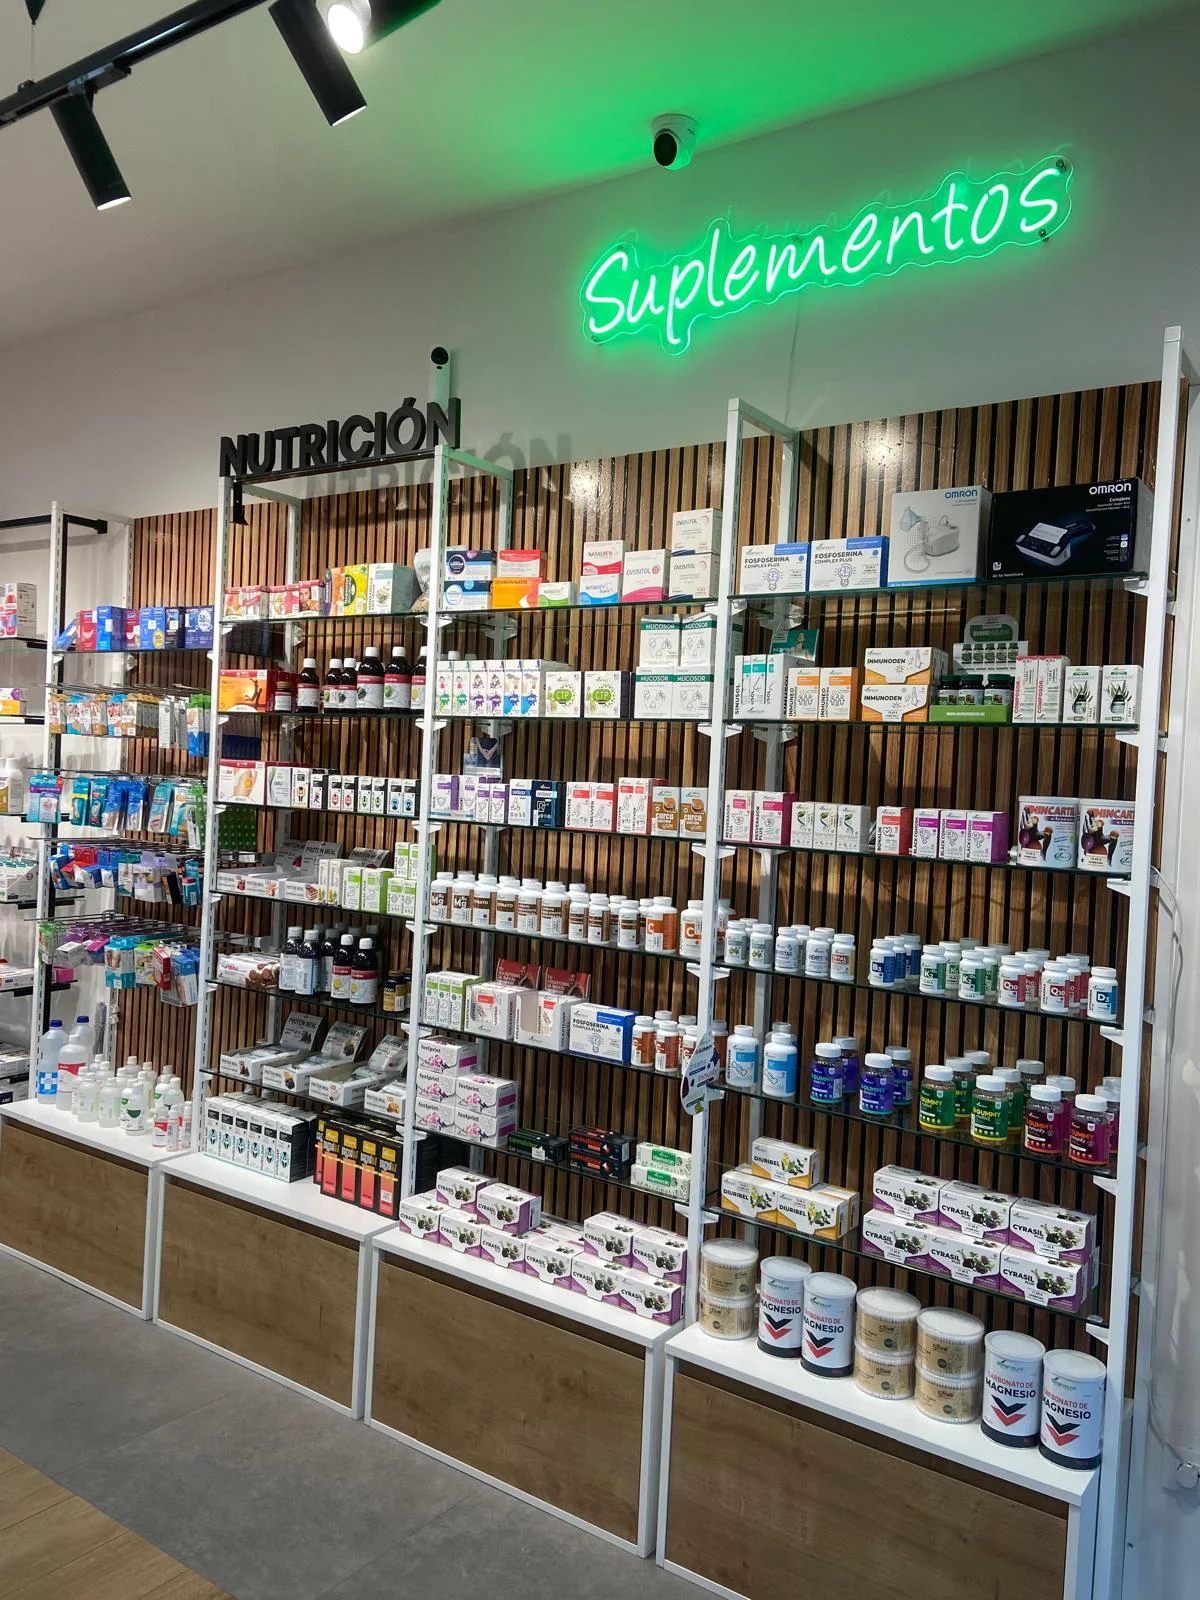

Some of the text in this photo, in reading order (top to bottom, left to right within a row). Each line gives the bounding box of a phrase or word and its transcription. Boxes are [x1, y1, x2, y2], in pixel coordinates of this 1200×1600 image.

[585, 168, 1060, 344] Suplementos
[220, 397, 461, 477] NUTRICIÓN
[945, 489, 977, 499] OMRON
[1089, 482, 1132, 495] OMRON
[744, 556, 790, 564] FOSFOSERINA
[815, 550, 863, 560] FOSFOSERINA
[626, 568, 651, 576] OVUSITOL
[685, 621, 708, 629] MUCOSOR
[556, 691, 569, 699] CTP
[595, 691, 608, 699] CTP
[306, 846, 324, 854] PROTEIN
[648, 922, 654, 933] C
[686, 926, 695, 937] C
[1003, 981, 1018, 991] Q10
[1050, 985, 1066, 996] Q10
[1097, 994, 1110, 1003] D3
[572, 1018, 609, 1030] FOSFOSERINA
[754, 1156, 781, 1167] DIURIBEL
[438, 1184, 454, 1193] CYRASIL
[875, 1188, 903, 1200] CYRASIL
[723, 1188, 749, 1201] DIURIBEL
[478, 1203, 496, 1213] CYRASIL
[779, 1204, 807, 1217] DIURIBEL
[941, 1204, 971, 1217] CYRASIL
[401, 1213, 417, 1222] CYRASIL
[441, 1226, 458, 1236] CYRASIL
[1012, 1223, 1045, 1237] CYRASIL
[584, 1233, 605, 1244] CYRASIL
[865, 1230, 893, 1243] CYRASIL
[482, 1240, 500, 1250] CYRASIL
[634, 1248, 655, 1260] CYRASIL
[931, 1248, 961, 1261] CYRASIL
[526, 1255, 546, 1266] CYRASIL
[573, 1271, 594, 1283] CYRASIL
[1003, 1268, 1035, 1282] CYRASIL
[621, 1288, 643, 1301] CYRASIL
[985, 1377, 1036, 1398] MAGNESIO
